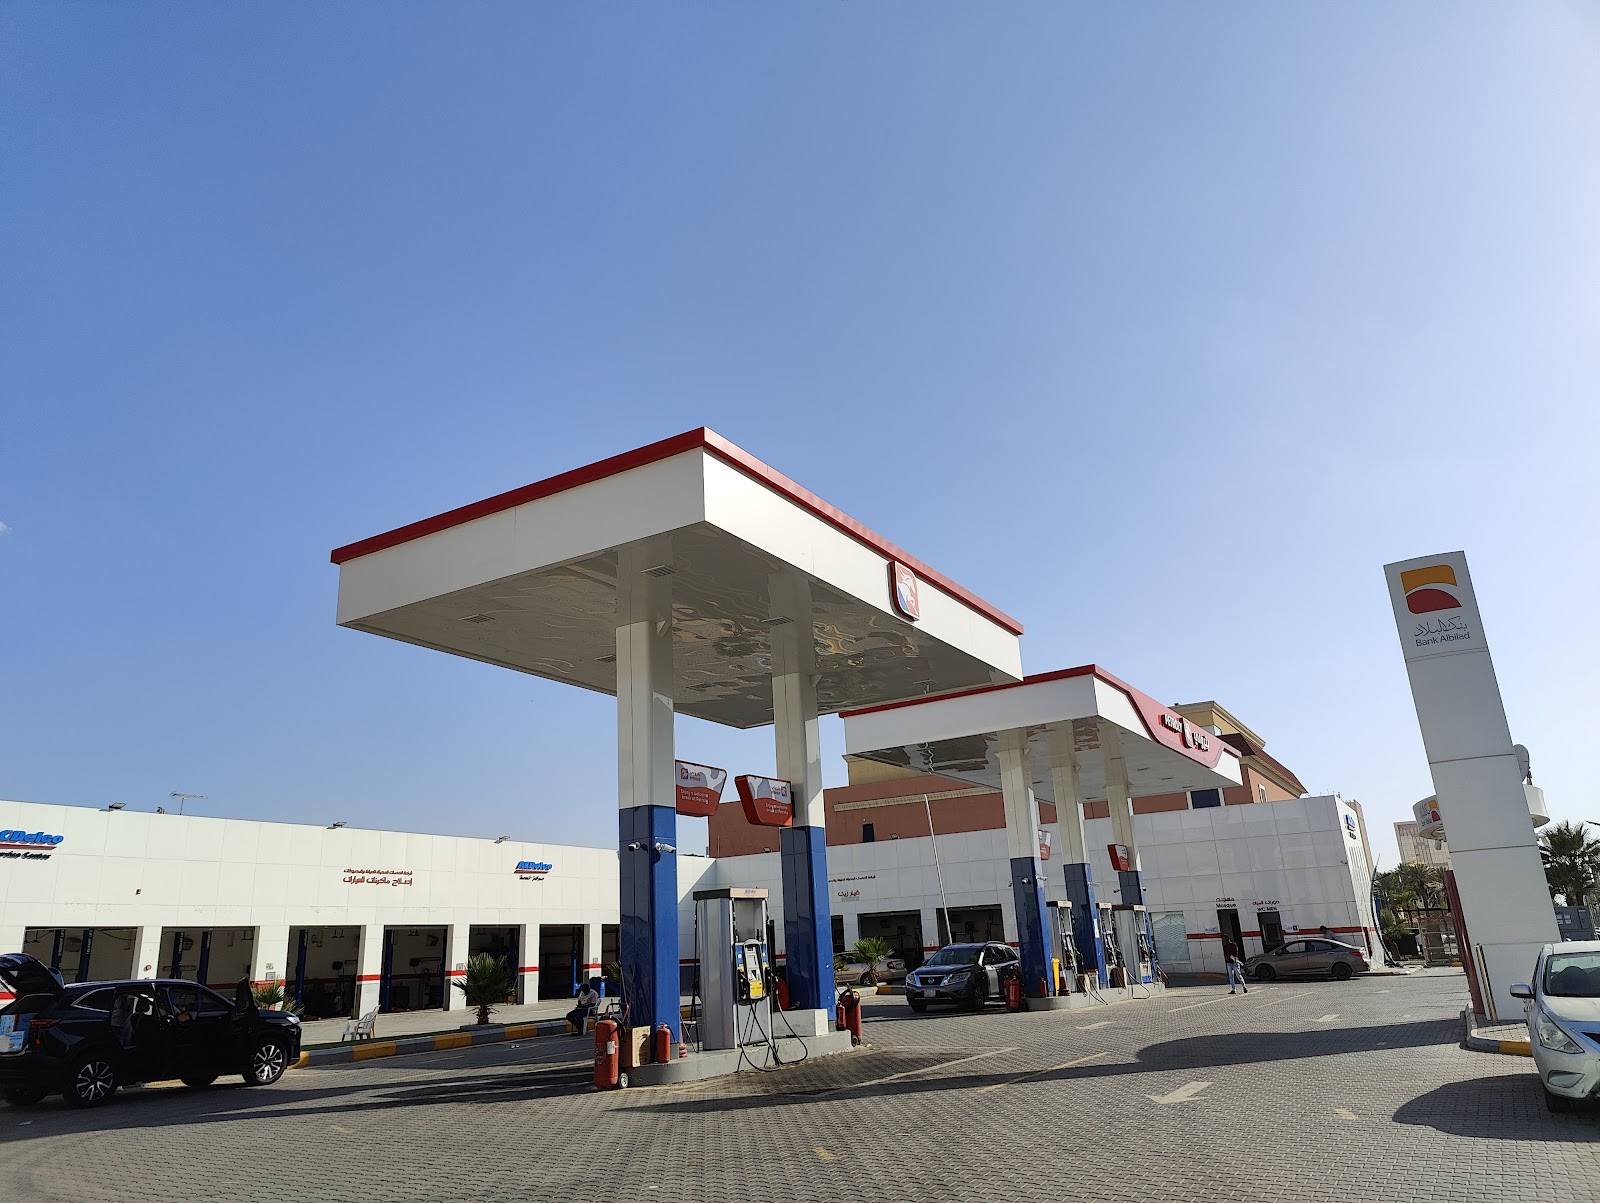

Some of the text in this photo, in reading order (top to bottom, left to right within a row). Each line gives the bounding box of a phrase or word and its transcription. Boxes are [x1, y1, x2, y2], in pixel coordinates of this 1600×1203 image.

[1415, 632, 1471, 647] Bank Albilad
[0, 829, 64, 845] CDelco
[21, 851, 52, 860] Center
[515, 860, 553, 870] ACDelco
